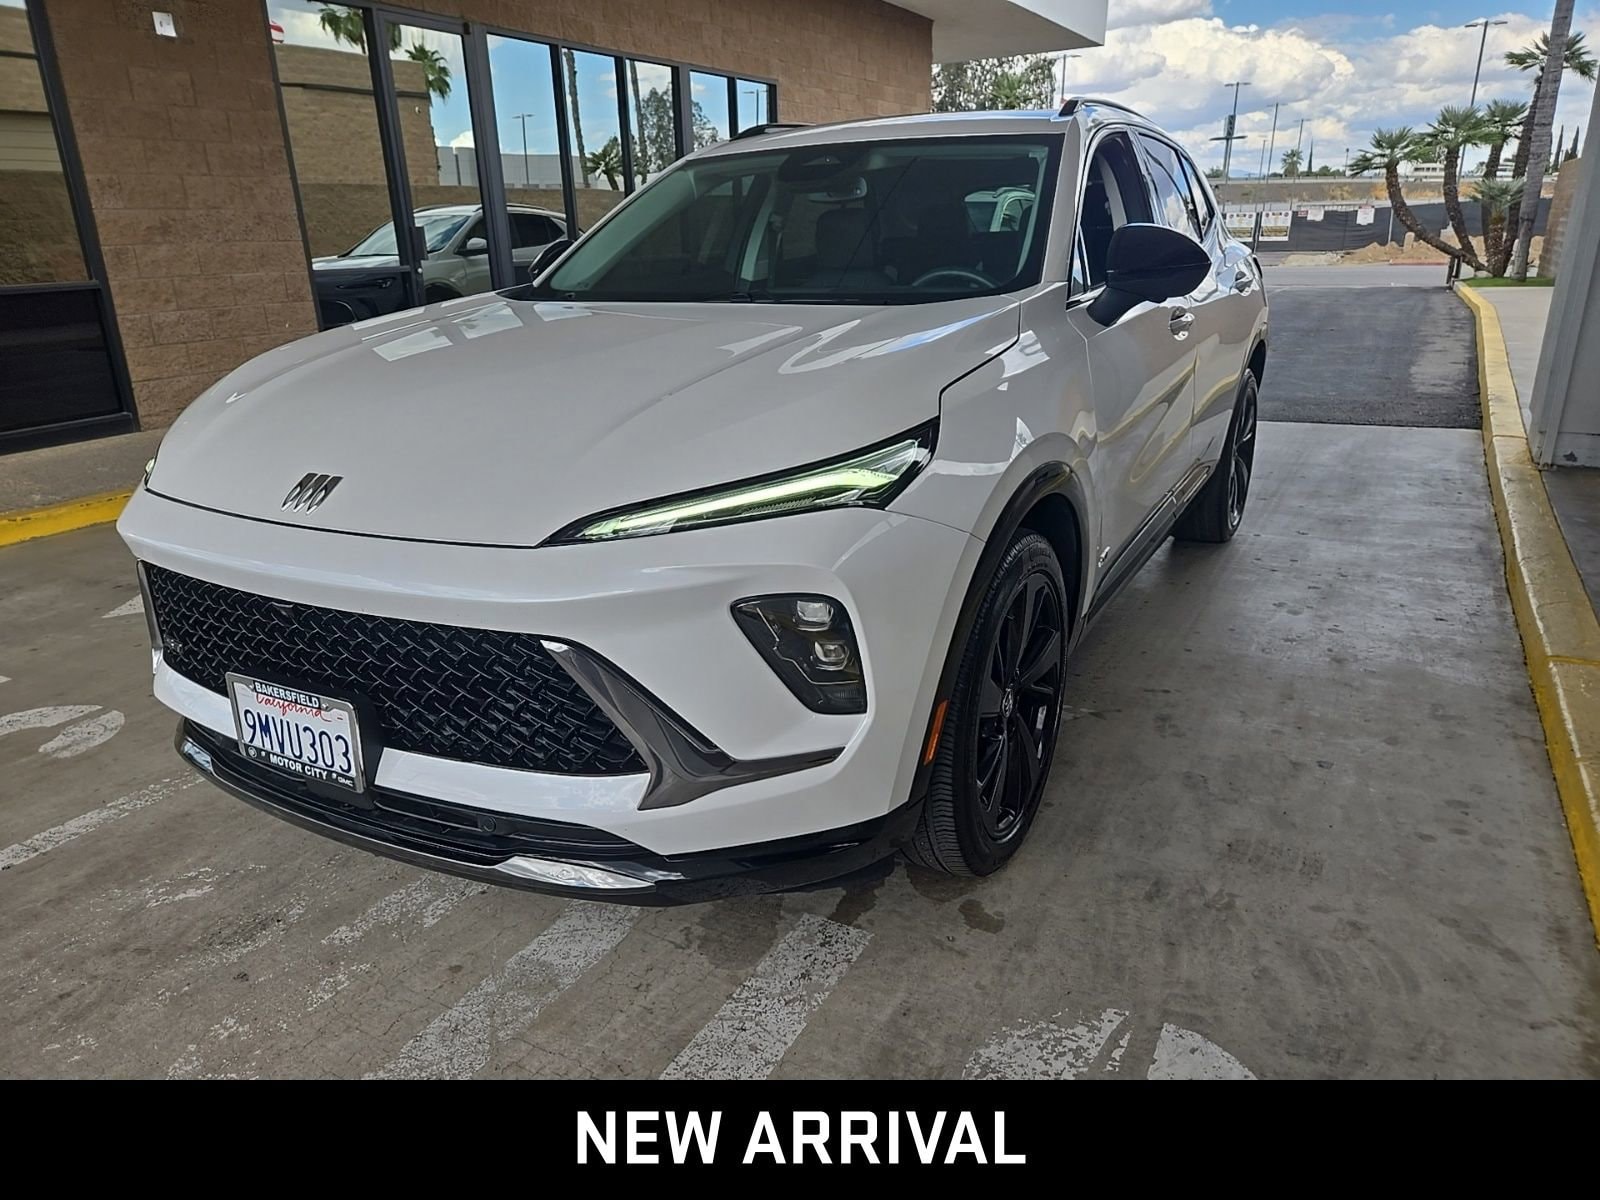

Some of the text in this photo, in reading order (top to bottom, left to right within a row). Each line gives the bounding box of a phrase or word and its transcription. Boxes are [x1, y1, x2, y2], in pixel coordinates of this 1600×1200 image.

[254, 682, 319, 708] BAKERSFIELD
[244, 709, 352, 774] 9MVU303
[270, 754, 303, 773] MOTOR
[305, 765, 328, 780] CITY
